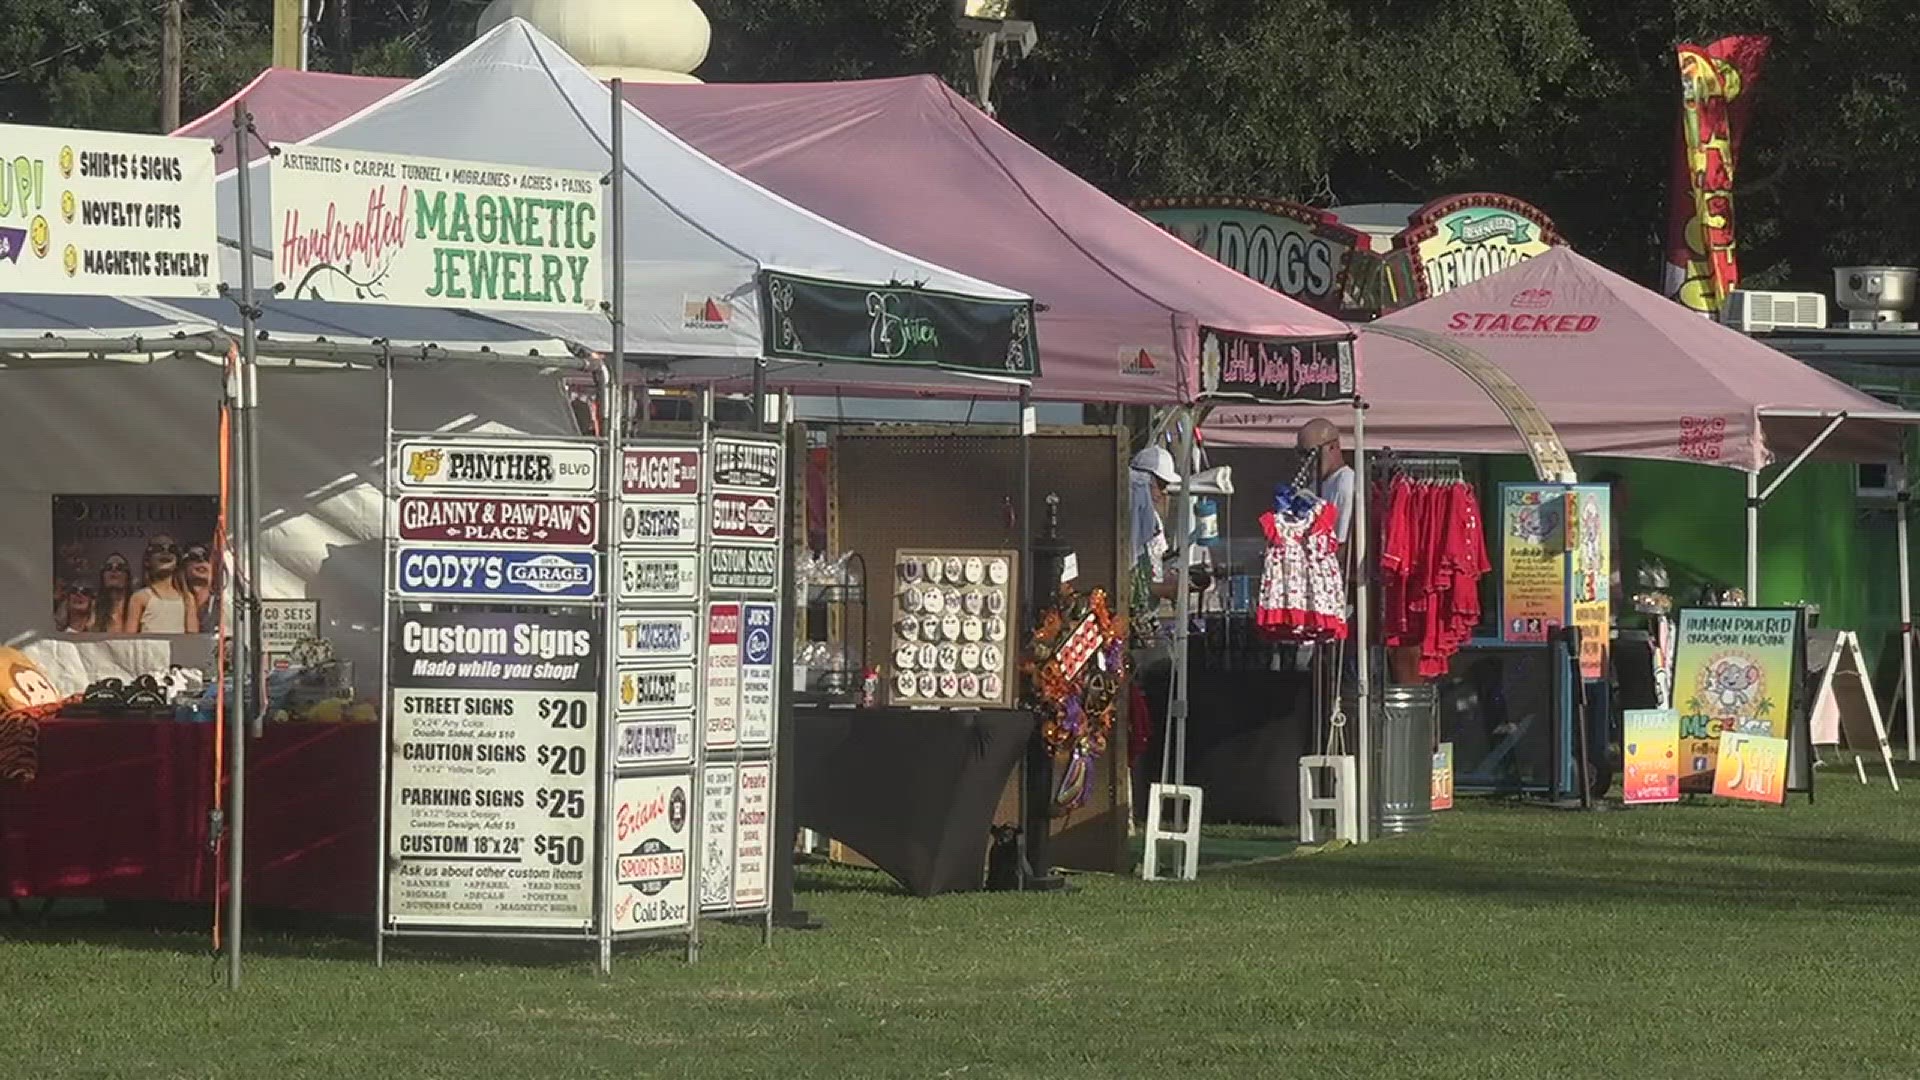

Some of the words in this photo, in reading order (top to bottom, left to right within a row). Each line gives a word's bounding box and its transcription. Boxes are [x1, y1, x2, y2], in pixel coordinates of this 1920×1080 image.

[80, 152, 127, 178] SHIRTS
[139, 155, 182, 181] SIGNS
[283, 154, 341, 174] ARTHRITIS
[353, 163, 395, 180] CARPAL
[401, 166, 442, 182] TUNNEL
[452, 170, 510, 187] MIGRAINES
[520, 175, 552, 191] ACHES
[562, 179, 593, 194] PAINS
[82, 200, 142, 227] NOVELTY
[145, 204, 181, 229] GIFTS
[415, 189, 595, 249] MAGNETIC
[282, 184, 410, 281] Handcrafted
[84, 250, 151, 275] MAGNETIC
[154, 252, 209, 277] JEWELRY
[1219, 220, 1332, 297] DOGS
[426, 248, 588, 304] JEWELRY
[1447, 311, 1601, 333] STACKED
[1224, 339, 1256, 382] Little
[1259, 342, 1290, 397] Daisy
[449, 452, 554, 482] PANTHER
[559, 463, 591, 476] BLVD
[639, 457, 681, 489] AGGIE
[404, 500, 481, 530] GRANNY
[482, 503, 496, 524] &
[502, 503, 592, 536] PAWPAW'S
[465, 526, 529, 540] PLACE
[405, 555, 503, 589] CODY'S
[515, 567, 584, 581] GARAGE
[284, 608, 312, 620] SETS
[403, 620, 508, 654] Custom
[514, 623, 592, 660] Signs
[412, 658, 457, 677] Made
[458, 660, 501, 678] while
[502, 664, 532, 680] you
[532, 662, 580, 681] shop!
[403, 697, 461, 715] STREET
[465, 698, 515, 716] SIGNS
[538, 698, 588, 729] $20
[403, 743, 473, 762] CAUTION
[477, 745, 526, 763] SIGNS
[537, 744, 587, 775] $20
[742, 773, 766, 789] Create
[401, 787, 471, 806] PARKING
[474, 789, 525, 808] SIGNS
[535, 787, 585, 819] $25
[400, 835, 468, 854] CUSTOM
[534, 834, 585, 866] $50
[400, 865, 420, 877] Ask
[424, 867, 438, 877] us
[441, 866, 473, 878] about
[475, 867, 506, 879] other
[508, 869, 550, 880] custom
[552, 869, 583, 881] items
[620, 857, 661, 878] SPORTS
[633, 901, 657, 924] Cold
[661, 899, 686, 921] Beer
